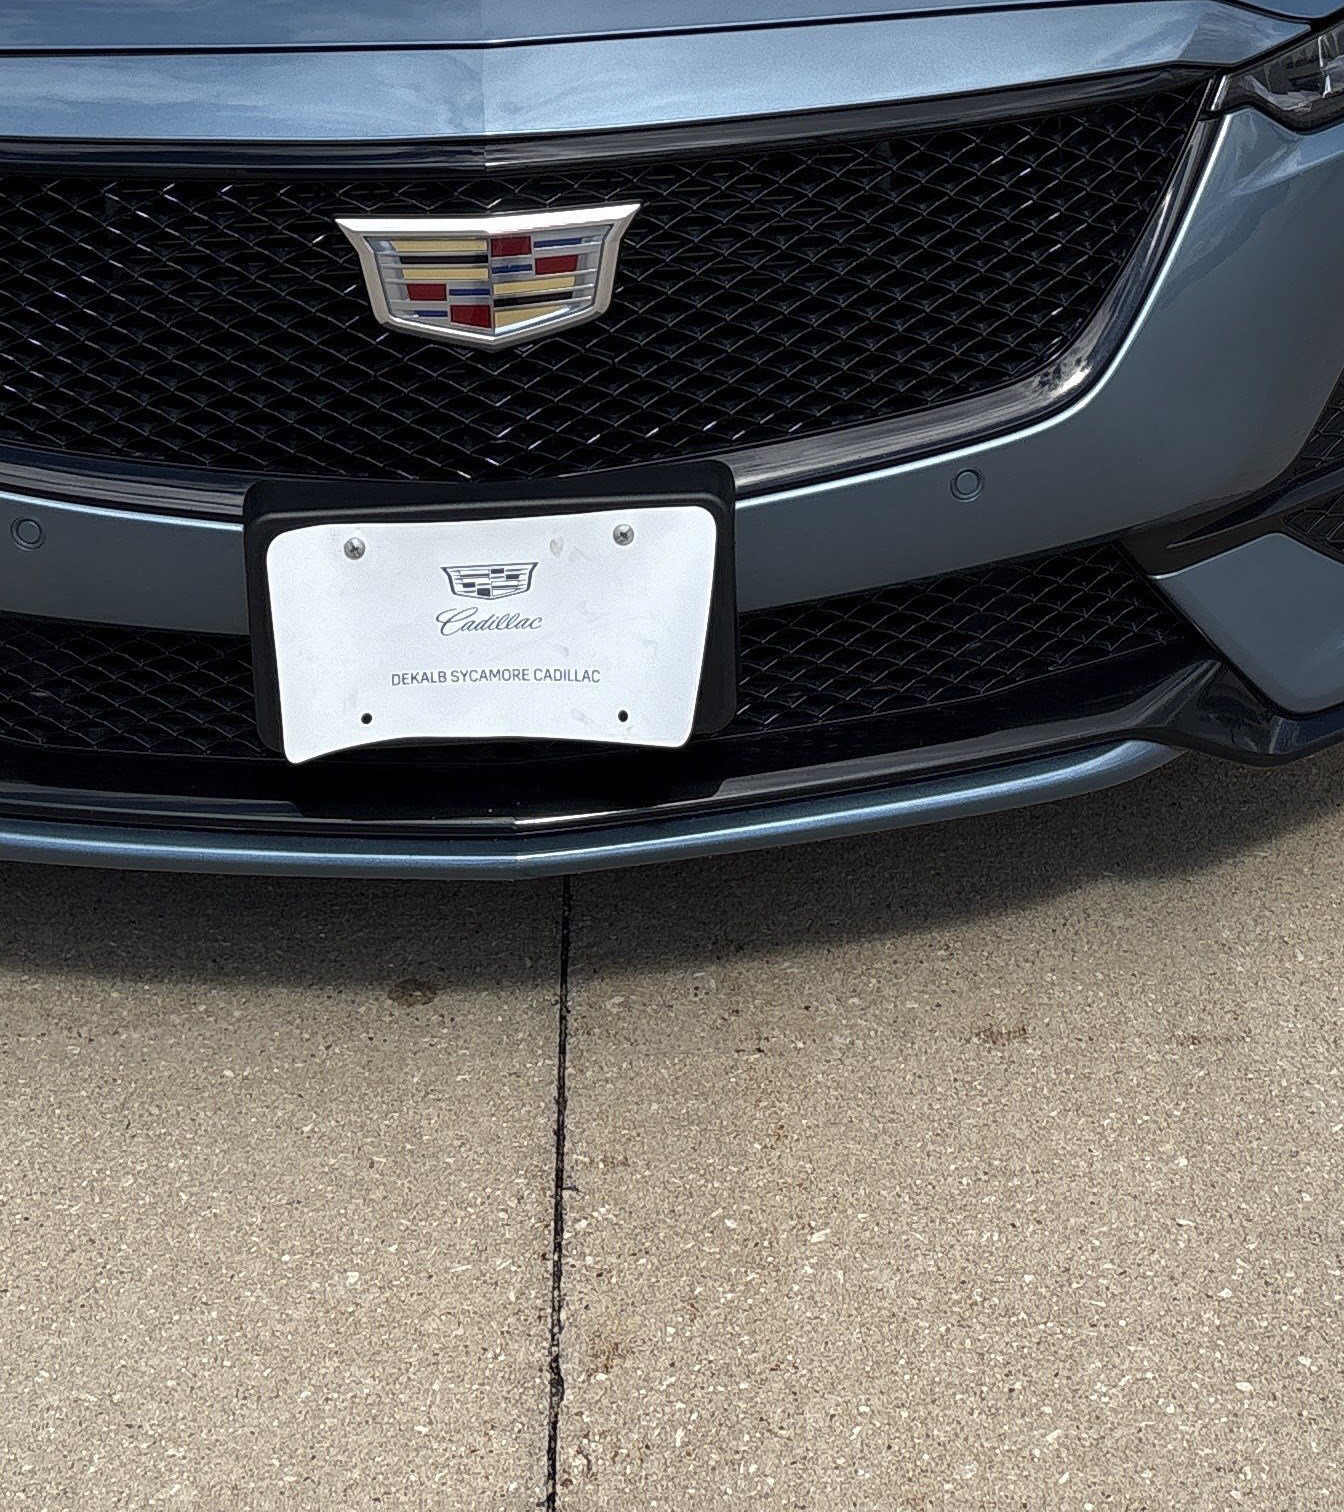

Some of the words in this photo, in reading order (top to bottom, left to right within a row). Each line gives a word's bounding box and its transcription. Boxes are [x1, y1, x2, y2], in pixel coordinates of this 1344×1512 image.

[436, 606, 542, 636] Cadillac
[391, 671, 447, 686] DEKALB
[451, 668, 529, 683] SYCAMORE
[533, 668, 600, 683] CADILLAC
